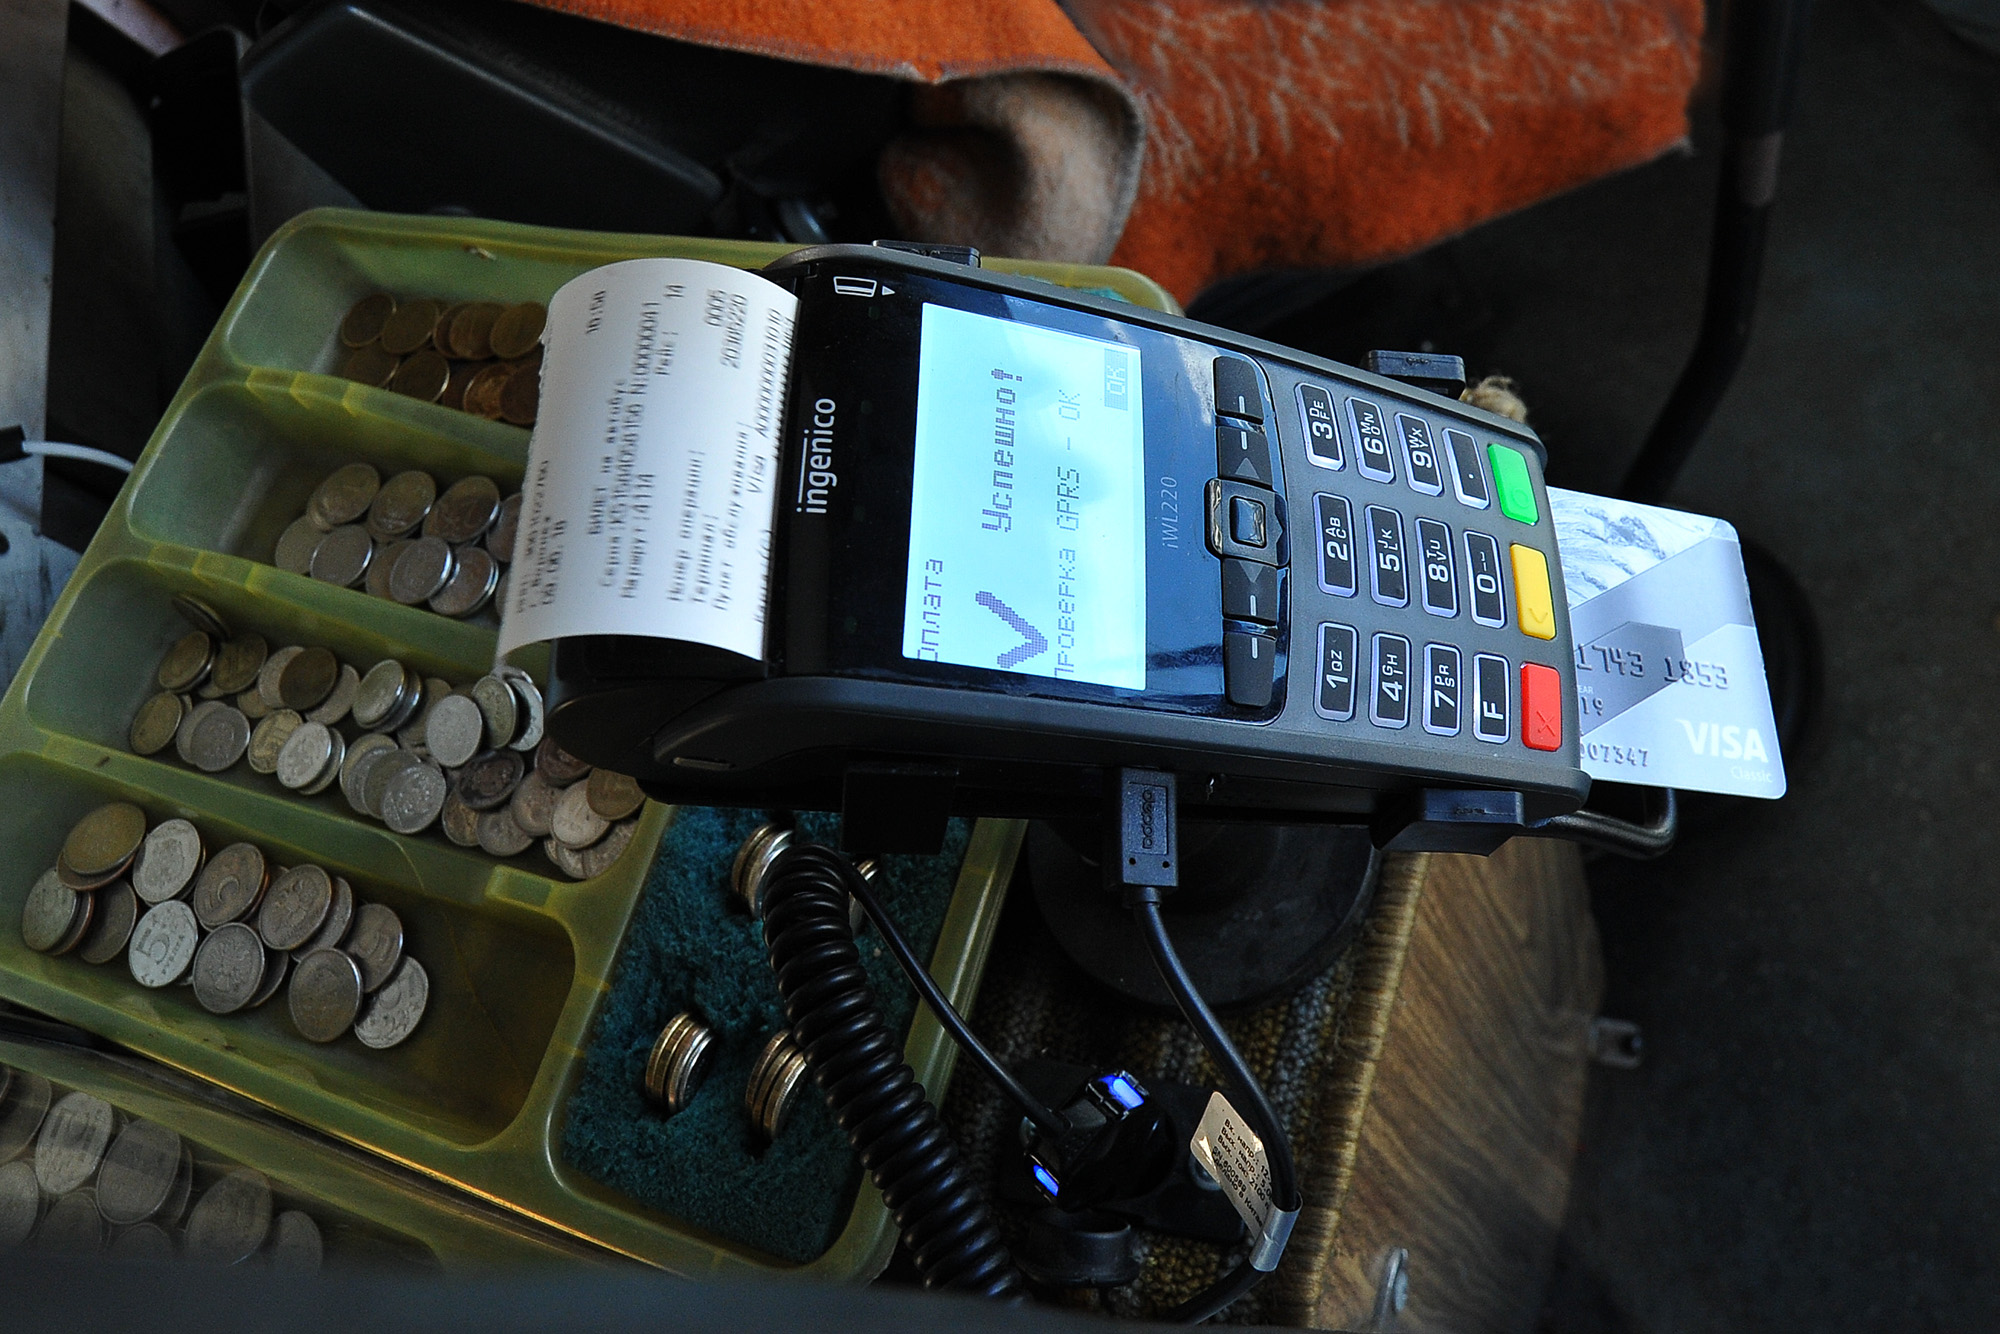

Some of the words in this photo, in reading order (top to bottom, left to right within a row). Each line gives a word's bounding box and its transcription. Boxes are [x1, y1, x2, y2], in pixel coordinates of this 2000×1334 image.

[663, 284, 686, 298] 14
[1107, 365, 1126, 396] OK
[1058, 389, 1080, 421] OK
[666, 549, 693, 602] Номер
[703, 289, 727, 327] 0005
[796, 398, 838, 514] ingenico
[982, 369, 1023, 533] Успешно!
[1056, 466, 1080, 531] GPRS
[1160, 476, 1179, 549] iWL220
[1476, 574, 1497, 594] 0
[917, 559, 943, 662] Оплата
[1576, 643, 1645, 679] 1743
[1663, 656, 1729, 689] 1853
[1577, 685, 1594, 694] EAR
[1483, 701, 1504, 720] F
[1675, 719, 1769, 763] VISA
[1730, 766, 1773, 783] Classic
[1221, 1126, 1236, 1149] Вых.
[1224, 1118, 1234, 1135] Вх.
[1217, 1134, 1232, 1157] Вых.
[1235, 1158, 1248, 1177] ток:
[1250, 1179, 1265, 1200] 2100
